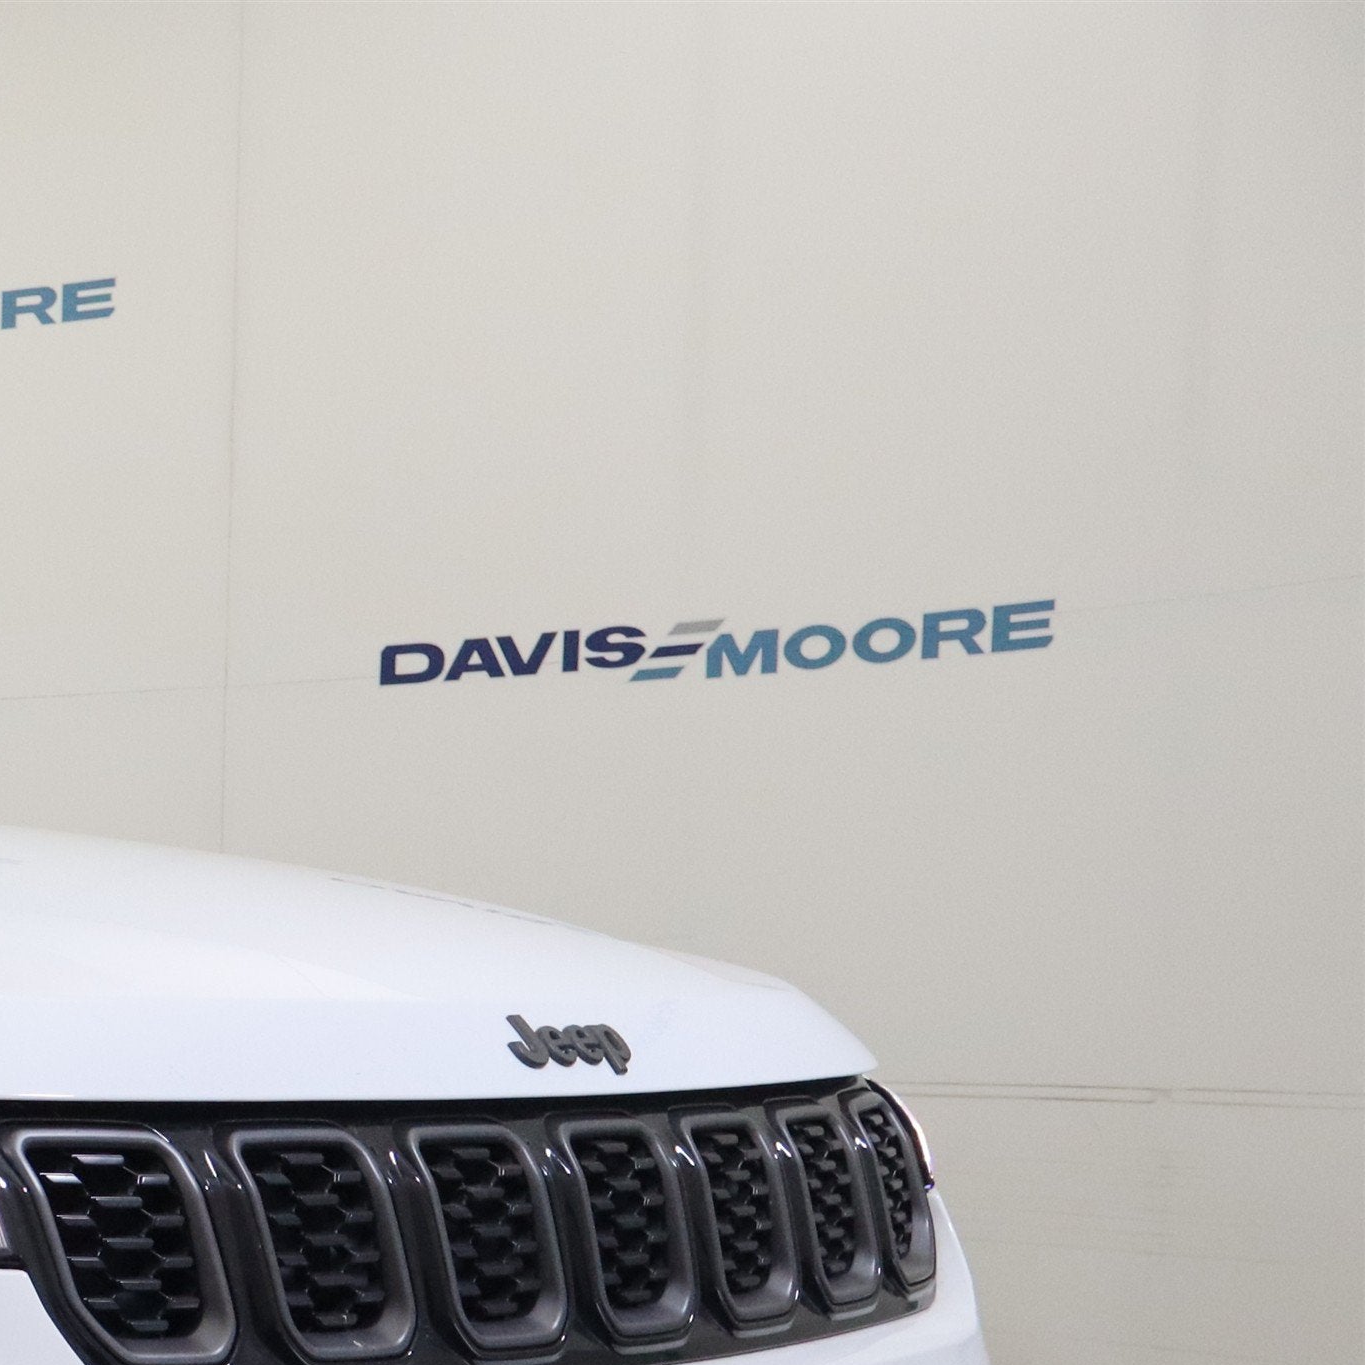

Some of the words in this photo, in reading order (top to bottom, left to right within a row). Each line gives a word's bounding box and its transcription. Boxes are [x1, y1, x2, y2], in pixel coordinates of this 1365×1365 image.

[379, 625, 651, 686] DAVIS
[705, 598, 1057, 679] MOORE
[505, 1014, 631, 1075] Jeep
